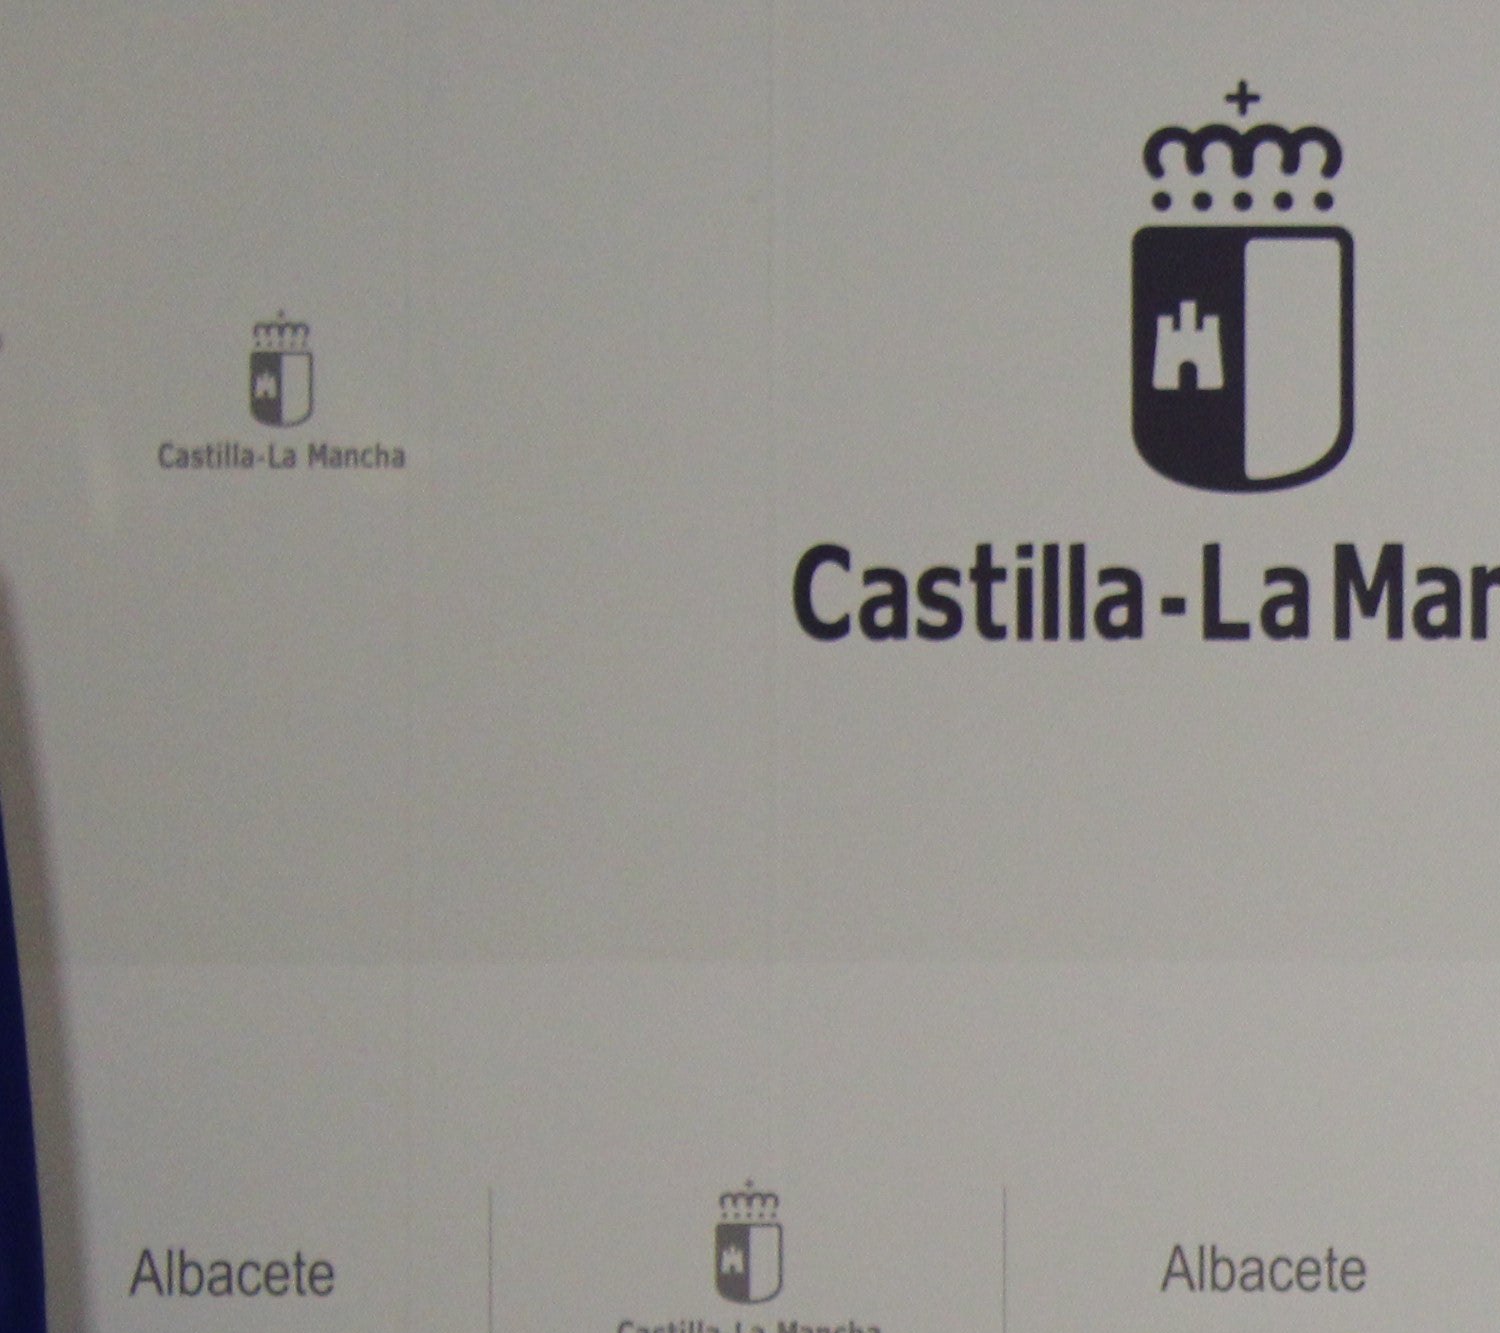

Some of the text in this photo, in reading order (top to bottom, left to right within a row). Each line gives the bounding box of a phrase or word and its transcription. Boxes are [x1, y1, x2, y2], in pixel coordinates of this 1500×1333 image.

[157, 442, 406, 470] Castilla-La Mancha
[128, 1247, 335, 1298] Albacete
[1160, 1243, 1367, 1293] Albacete
